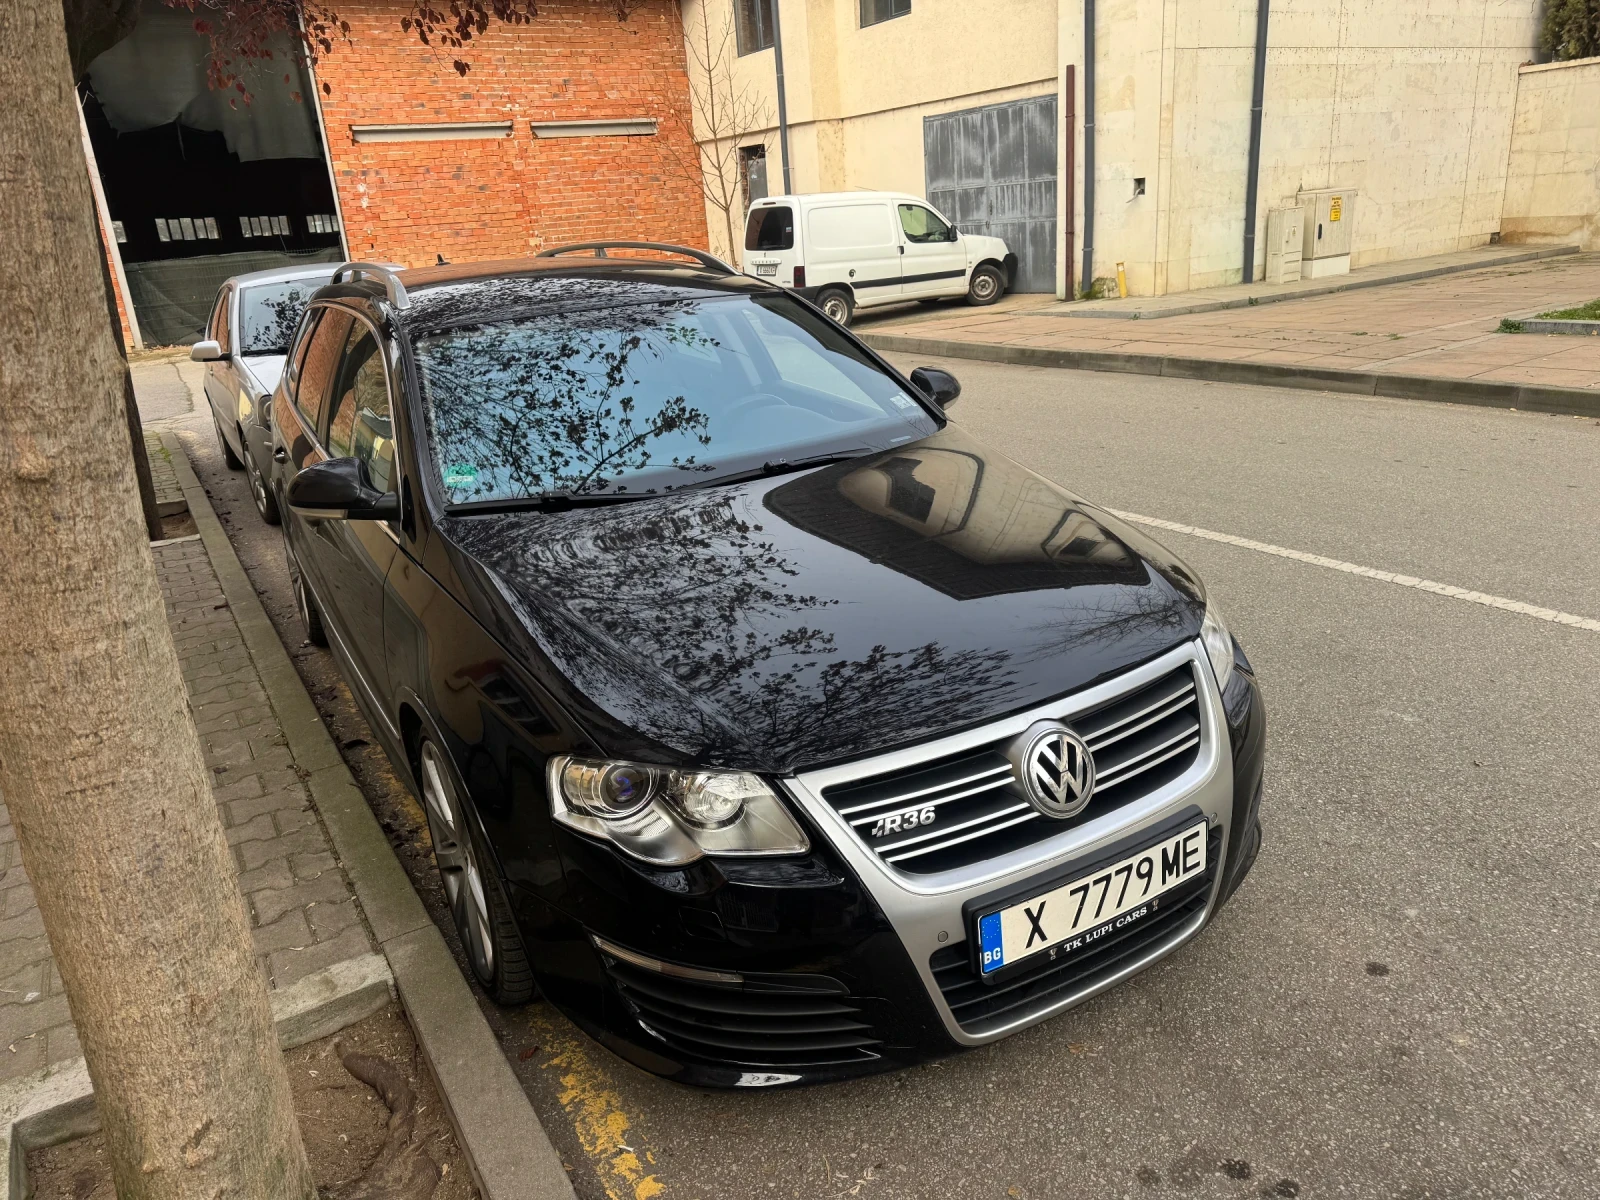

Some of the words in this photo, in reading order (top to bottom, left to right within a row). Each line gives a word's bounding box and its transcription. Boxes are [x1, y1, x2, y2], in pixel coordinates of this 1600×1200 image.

[1029, 733, 1088, 806] VW
[882, 806, 936, 836] R36
[1023, 900, 1048, 949] X
[1069, 856, 1154, 930] 7779
[1161, 830, 1201, 886] ME
[1063, 938, 1083, 953] TK
[1085, 922, 1114, 942] LUPI
[1116, 906, 1148, 928] CARS
[983, 947, 1002, 965] BG
